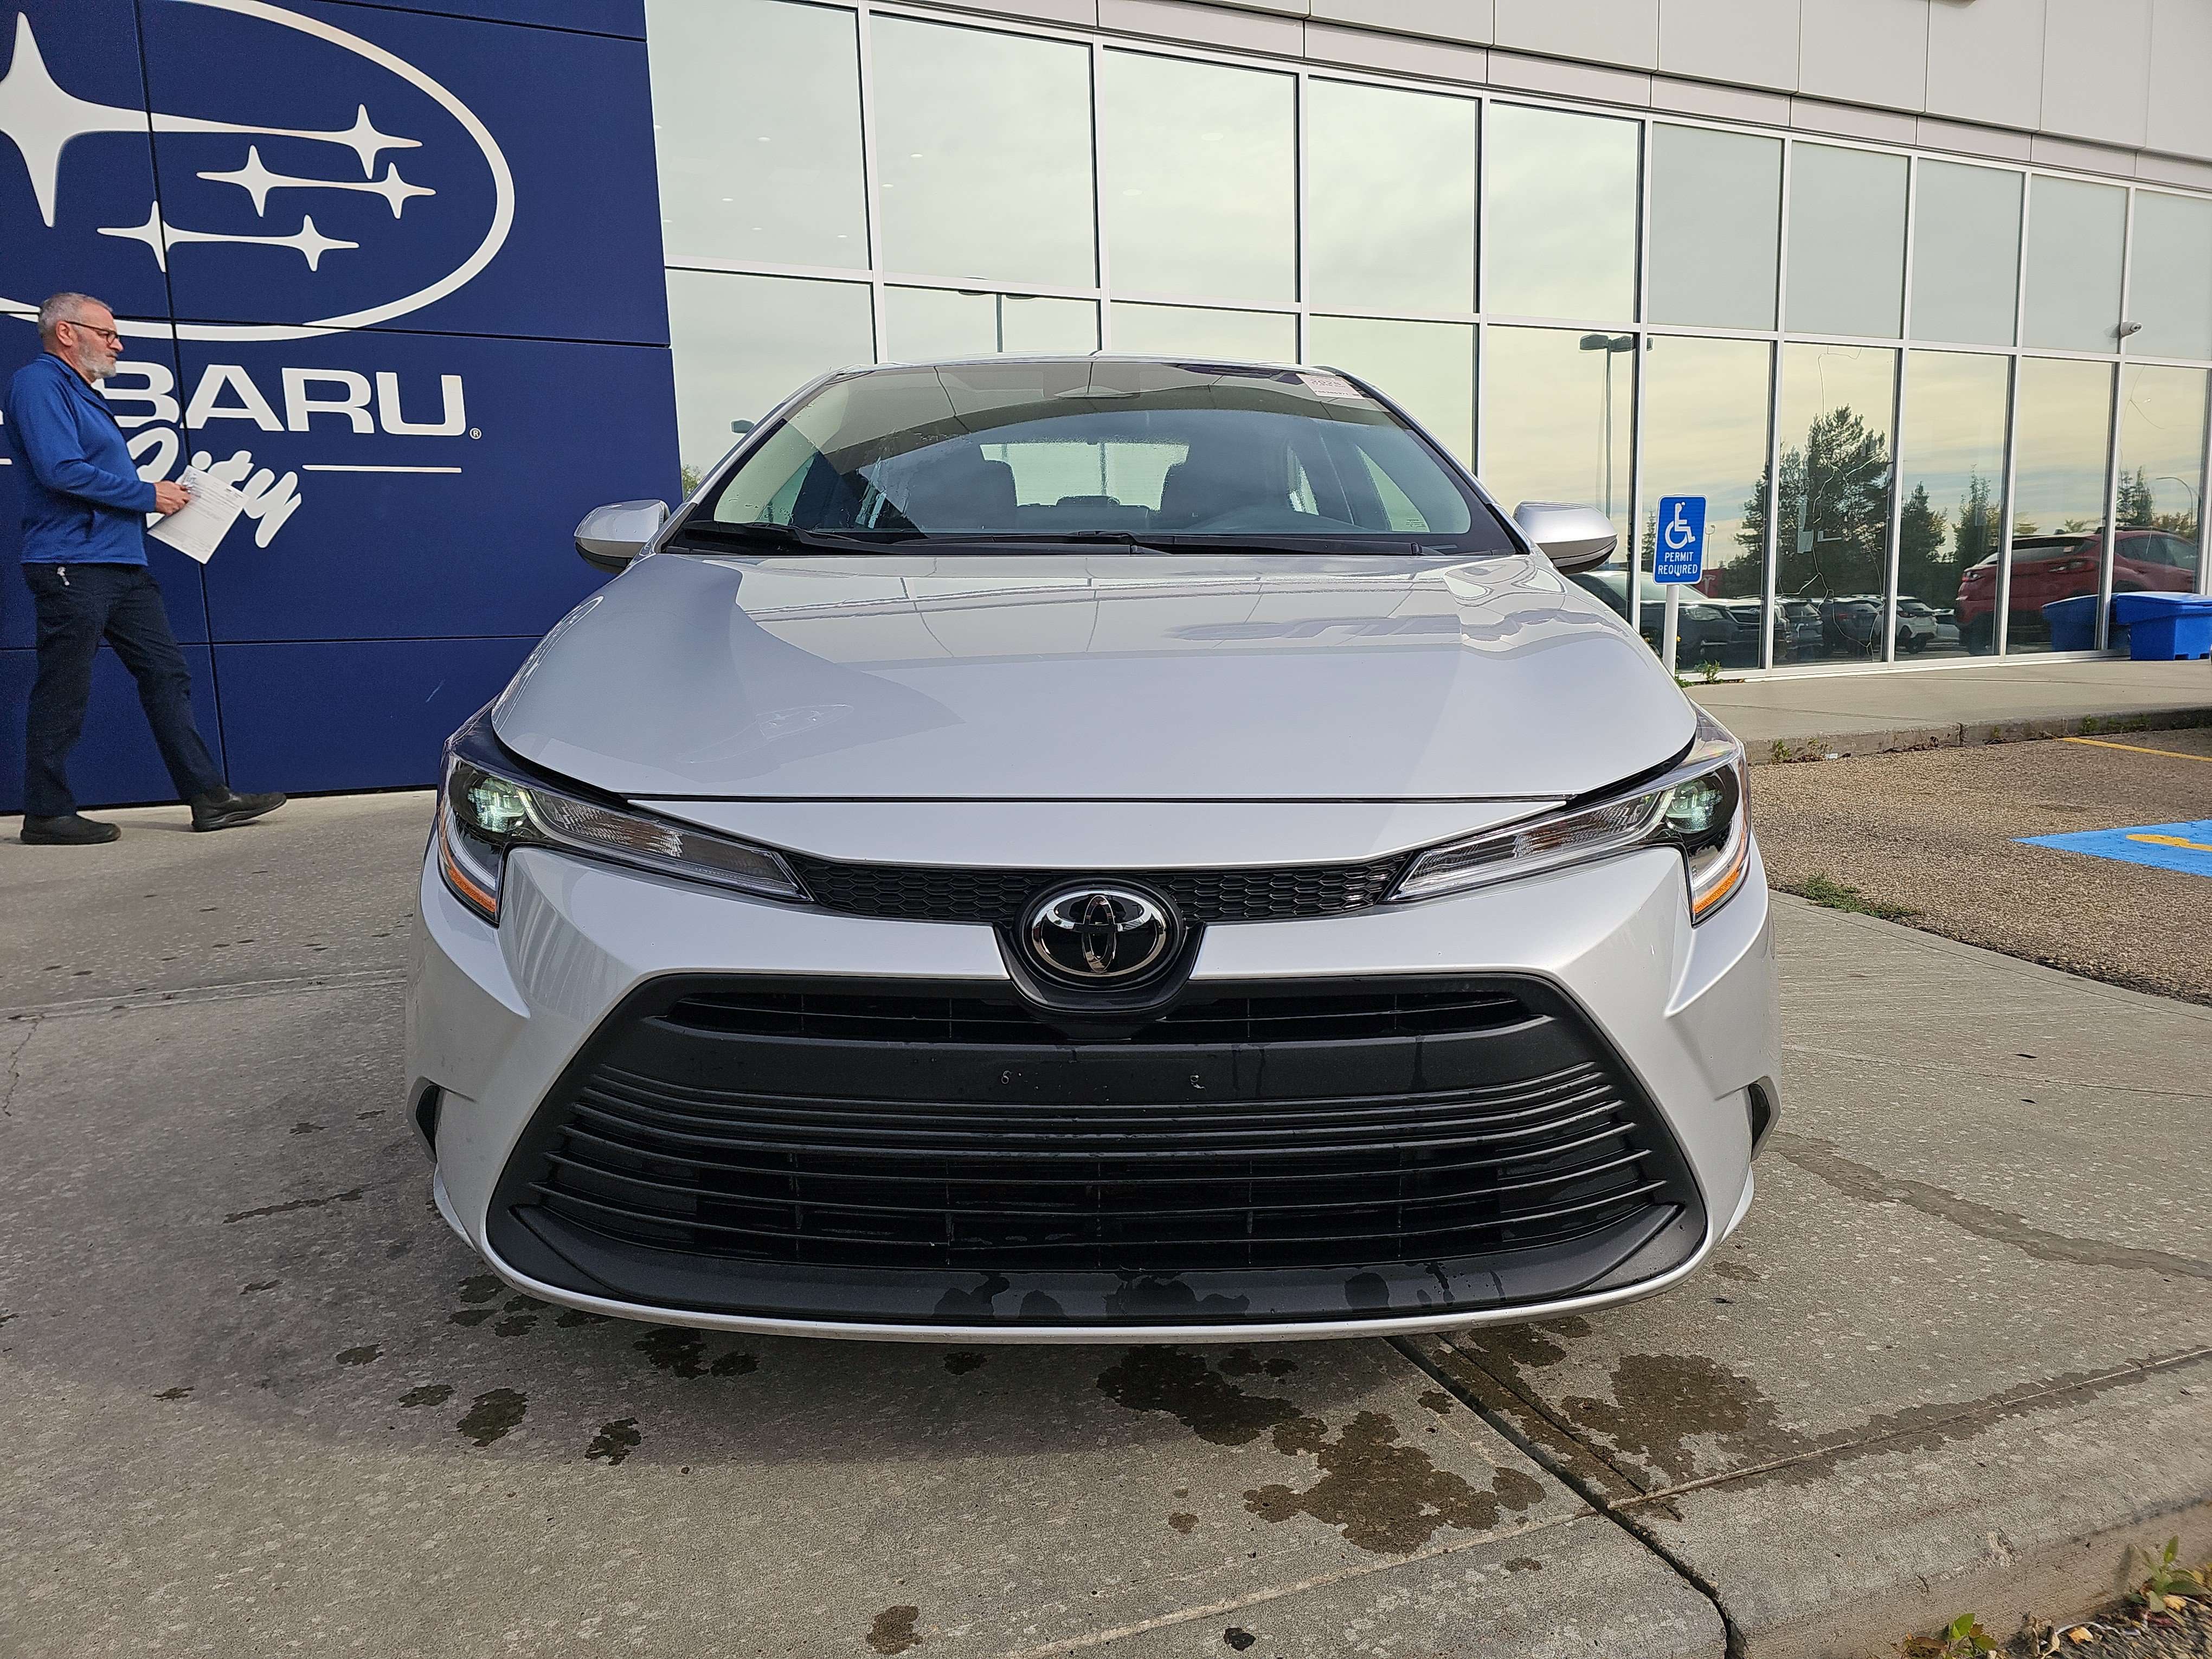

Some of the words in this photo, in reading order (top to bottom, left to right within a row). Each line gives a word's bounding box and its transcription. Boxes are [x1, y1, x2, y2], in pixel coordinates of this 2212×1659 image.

[0, 361, 466, 435] BARU
[127, 427, 301, 548] ty
[1658, 564, 1697, 575] REQUIRED
[1664, 552, 1694, 562] PERMIT
